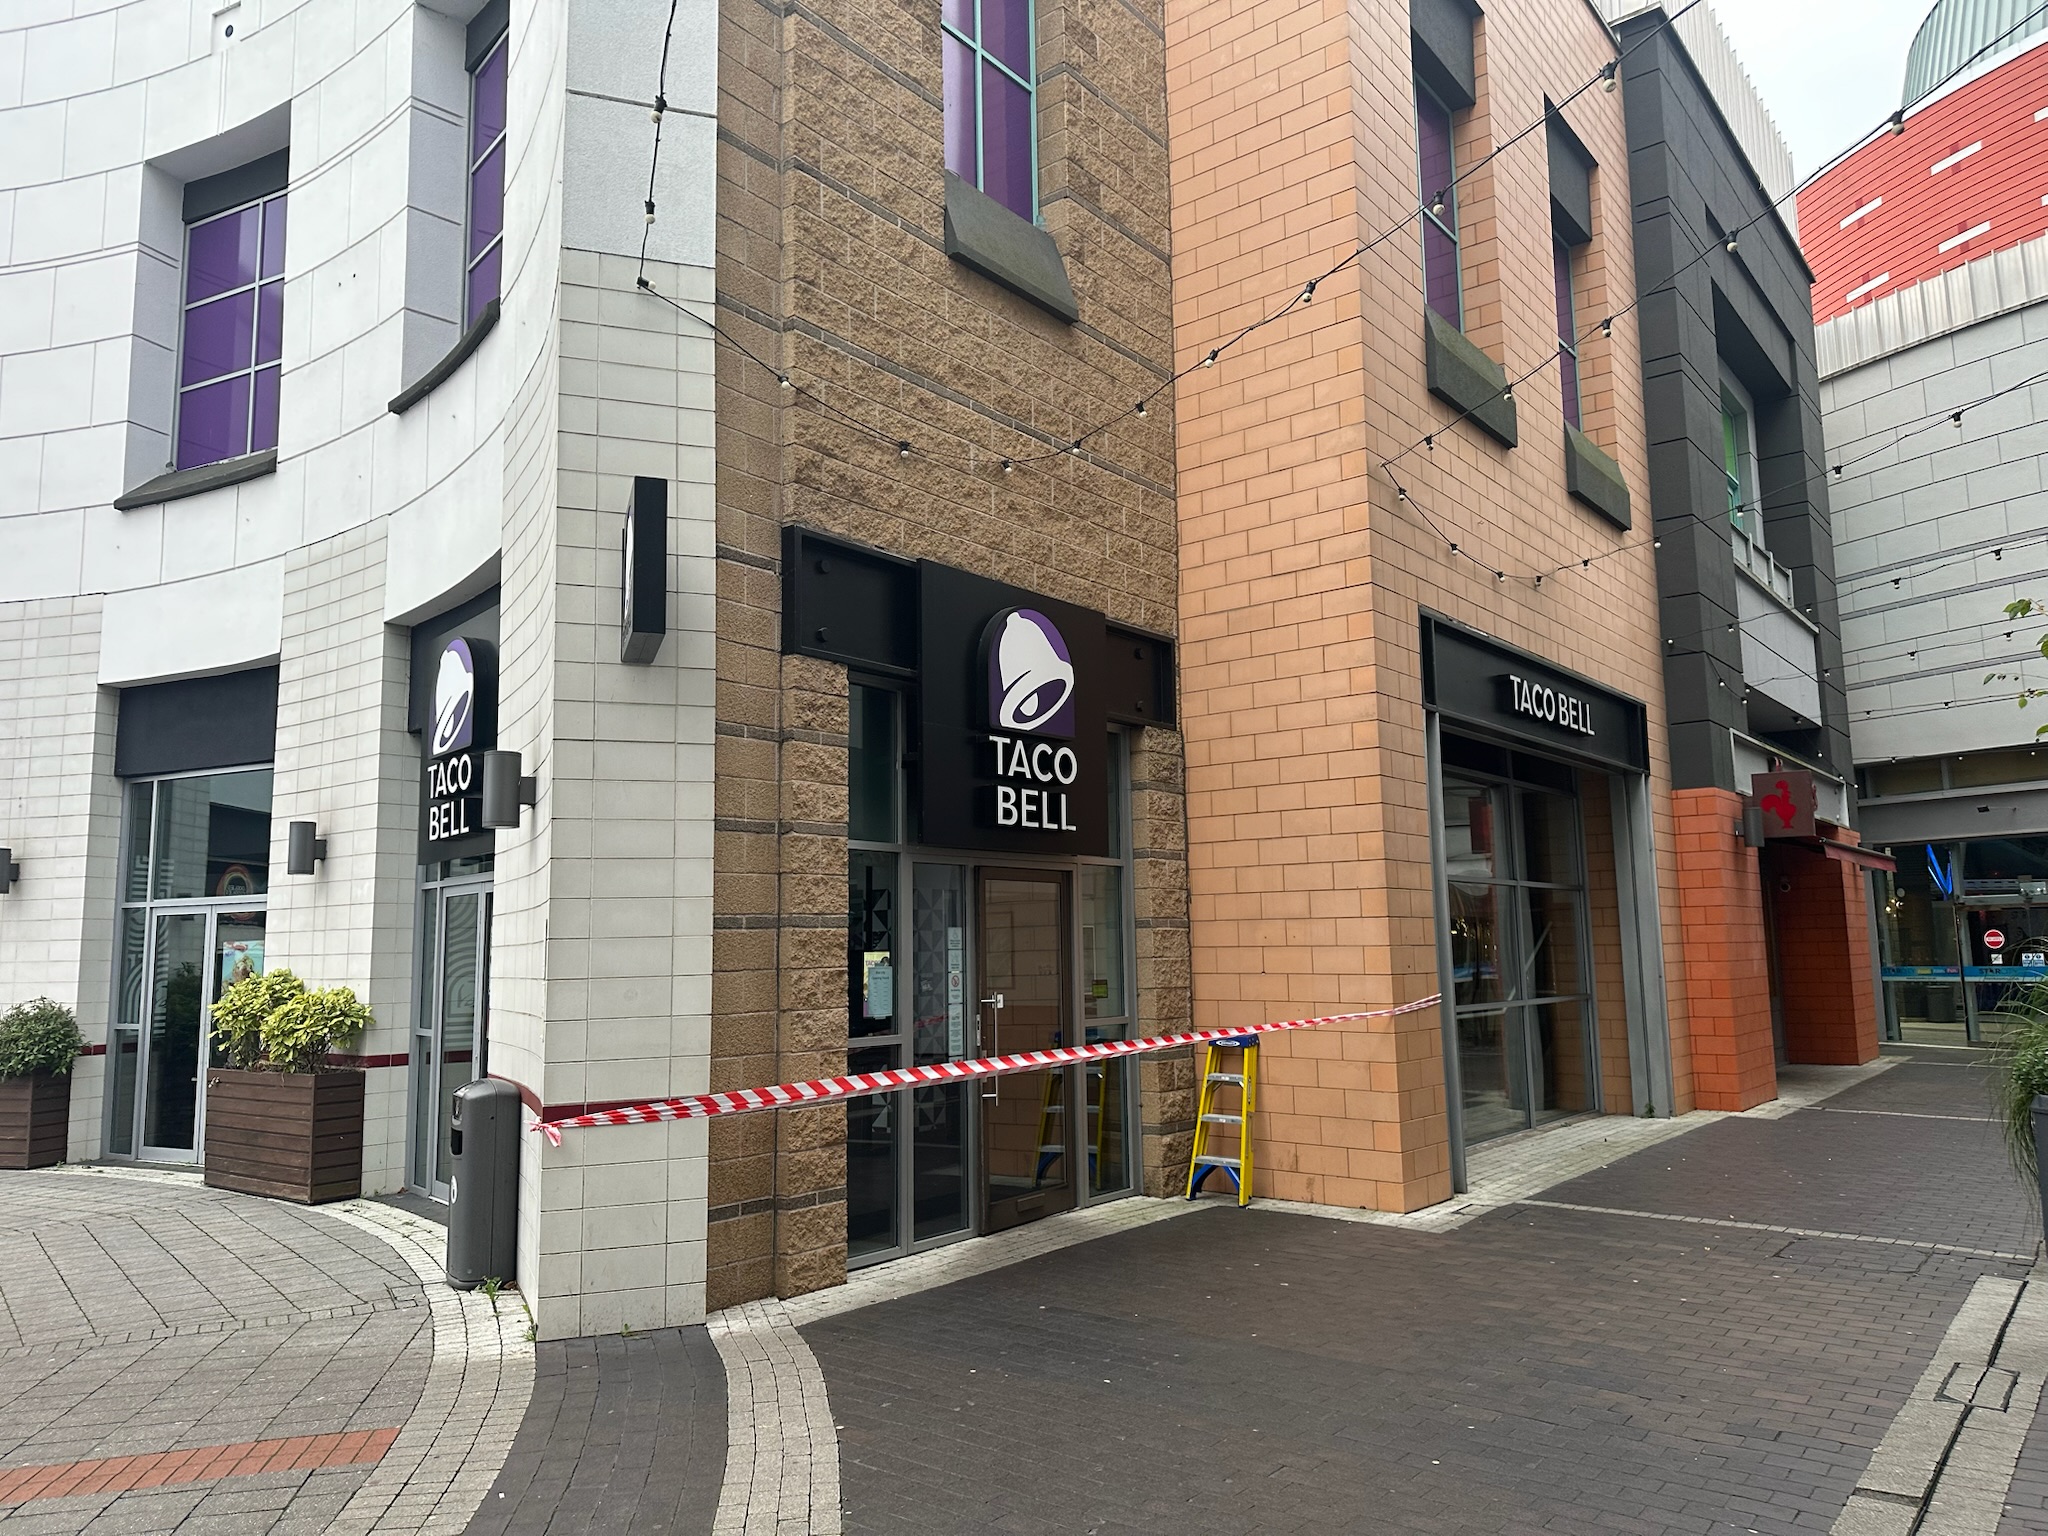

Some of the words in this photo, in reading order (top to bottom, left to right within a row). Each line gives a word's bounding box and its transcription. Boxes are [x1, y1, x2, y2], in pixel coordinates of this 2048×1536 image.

[1510, 675, 1555, 721] TACO
[1558, 692, 1595, 735] BELL
[427, 754, 472, 799] TACO
[989, 735, 1078, 784] TACO
[429, 798, 470, 841] BELL
[997, 785, 1077, 831] BELL
